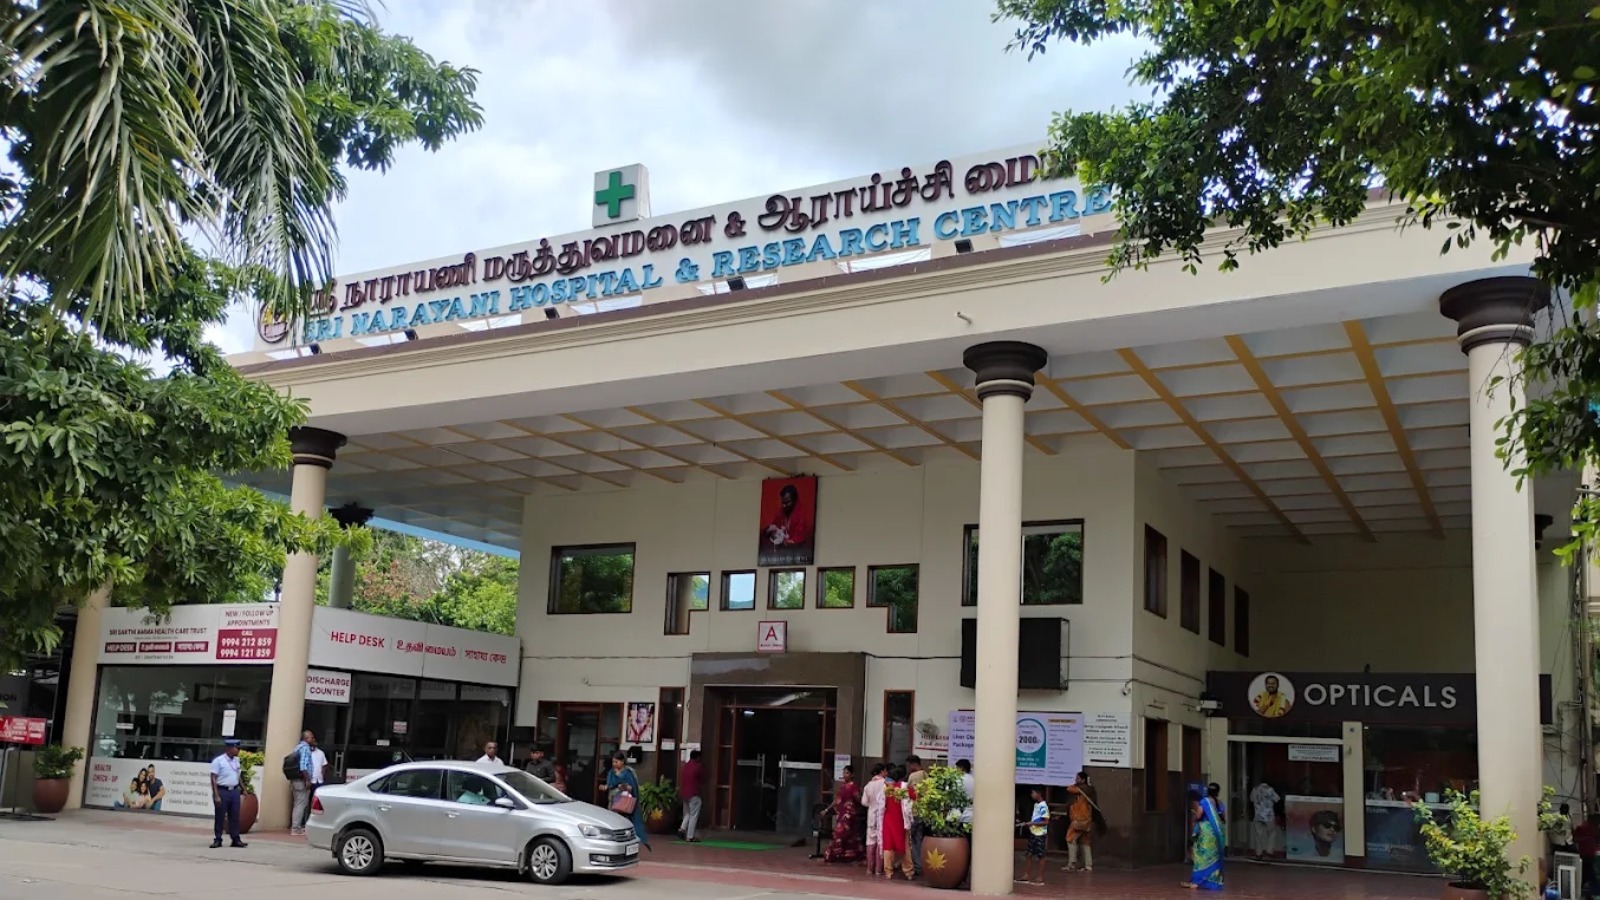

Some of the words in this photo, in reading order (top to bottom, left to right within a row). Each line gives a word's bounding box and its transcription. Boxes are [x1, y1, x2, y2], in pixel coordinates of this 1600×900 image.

[340, 252, 476, 312] நாராயணி
[484, 215, 716, 282] மருத்துவமனை
[723, 211, 746, 238] &
[757, 160, 953, 233] ஆராய்ச்சி
[304, 315, 343, 343] SRI
[350, 290, 500, 336] NARAYANI
[510, 263, 662, 312] HOSPITAL
[675, 257, 699, 284] &
[711, 217, 920, 277] RESEARCH
[934, 183, 1112, 240] CENTRE
[227, 619, 270, 627] APPOINTMENTS
[190, 627, 207, 635] TRUST
[765, 626, 778, 641] A
[221, 638, 240, 647] 9994
[241, 638, 256, 647] 212
[257, 637, 272, 646] 859
[330, 631, 357, 645] HELP
[359, 636, 385, 649] DESK
[220, 649, 239, 657] 9994
[241, 649, 254, 657] 121
[256, 649, 271, 657] 859
[396, 639, 424, 653] உதவி
[425, 643, 456, 657] மையம்
[307, 675, 350, 687] DISCHARGE
[310, 686, 345, 697] COUNTER
[1304, 682, 1457, 709] OPTICALS
[94, 764, 112, 772] HEALTH
